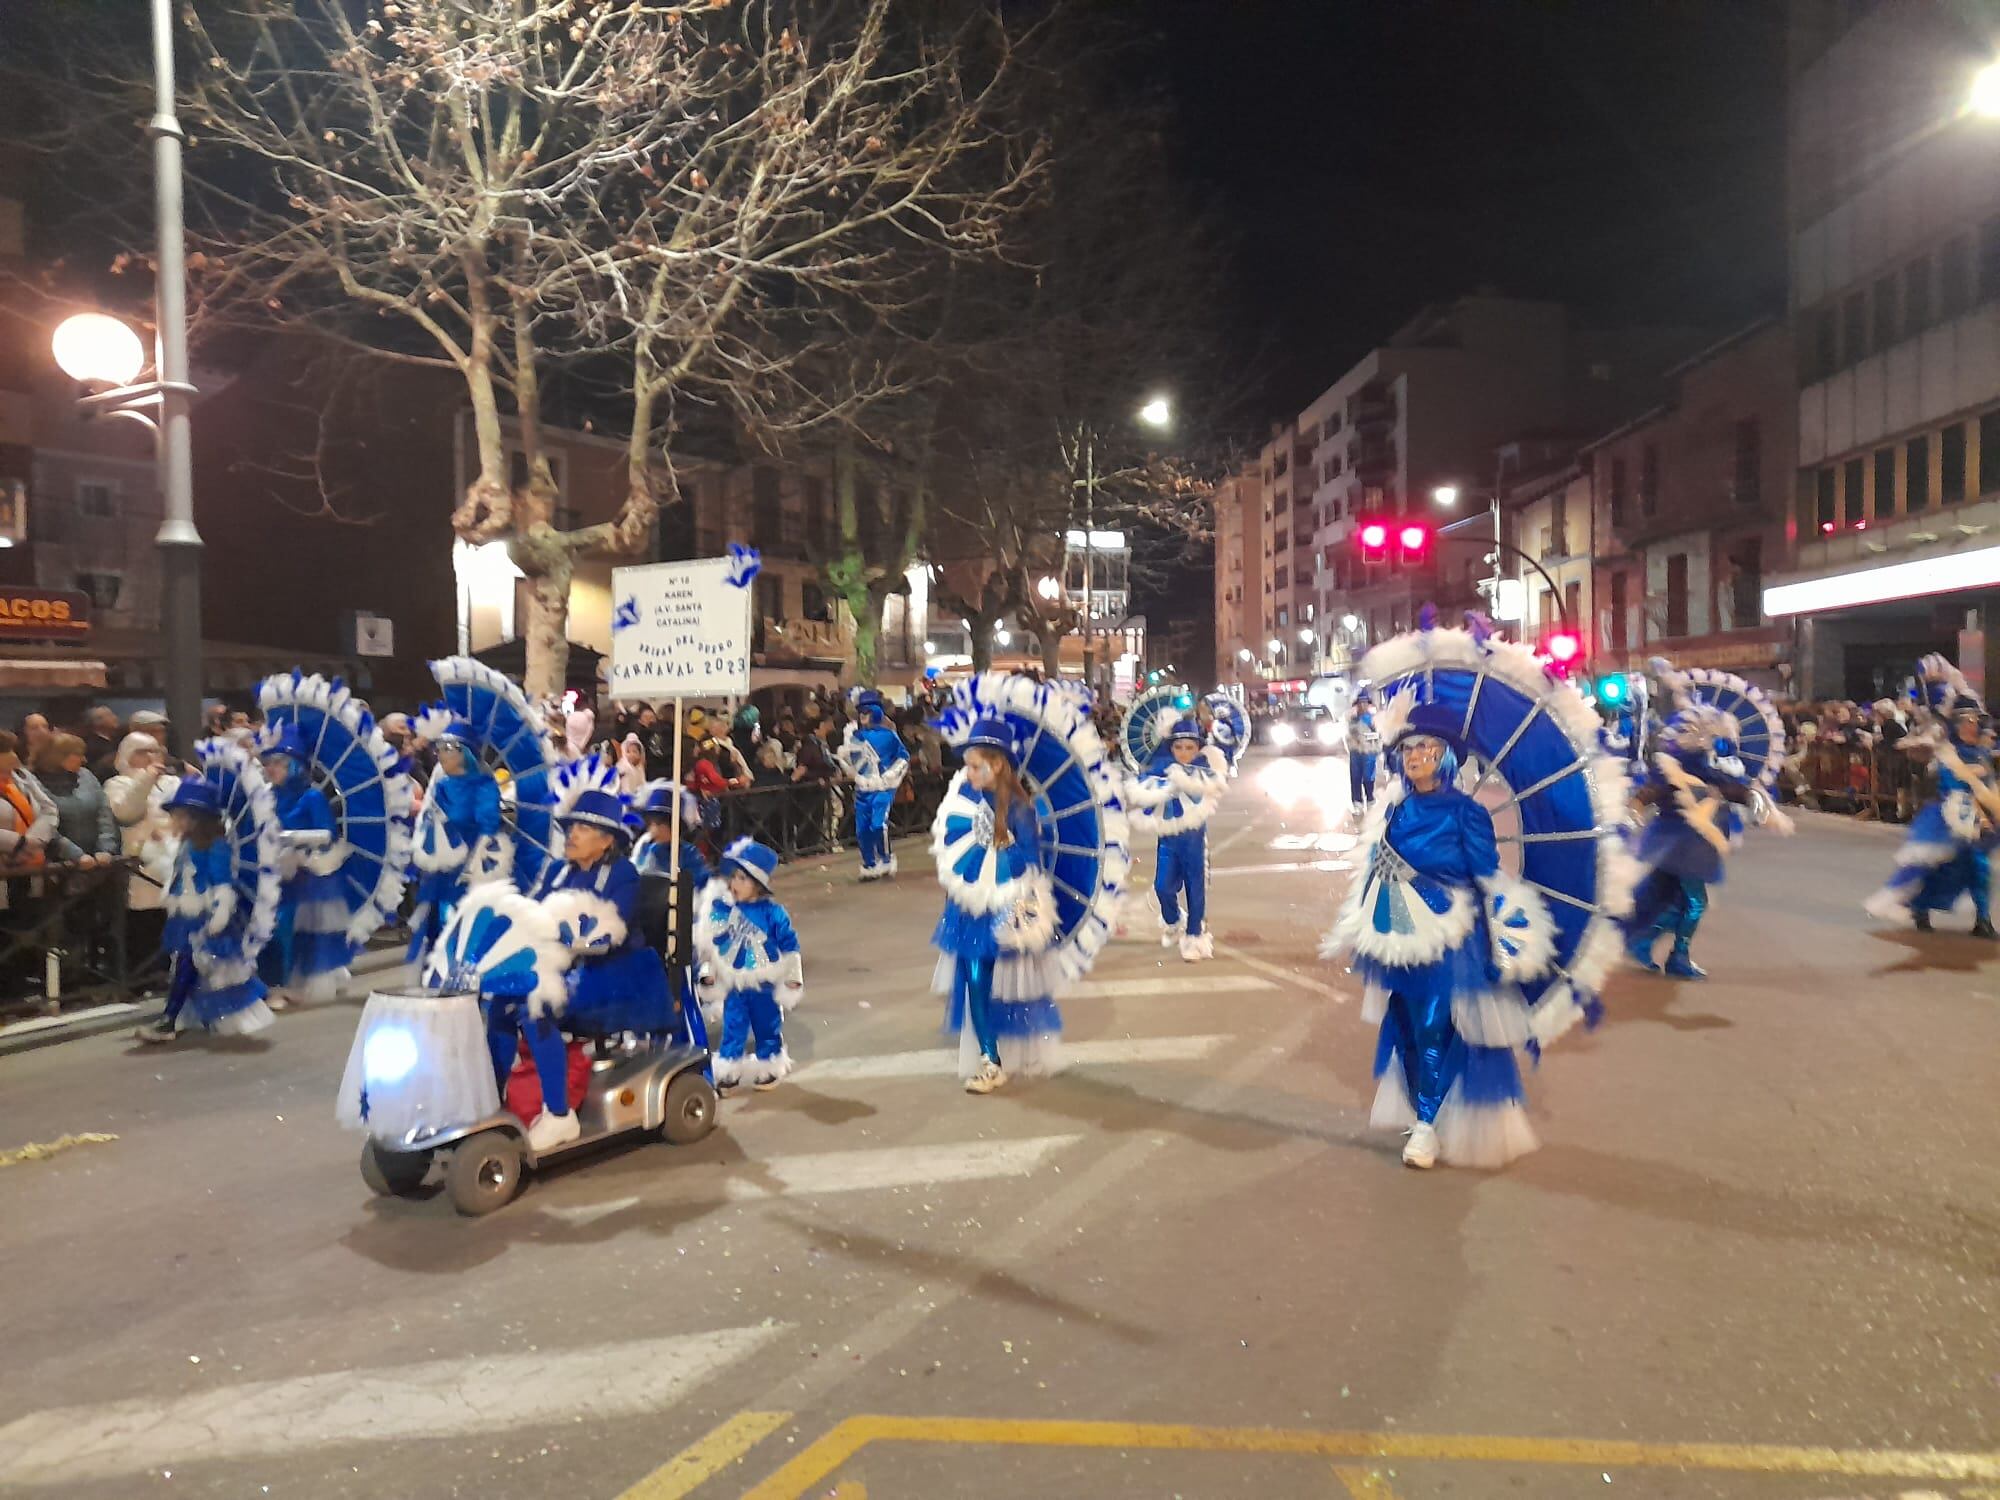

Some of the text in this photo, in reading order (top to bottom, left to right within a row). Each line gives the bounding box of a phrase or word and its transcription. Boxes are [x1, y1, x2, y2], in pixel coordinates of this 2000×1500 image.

[664, 590, 693, 599] KAREN
[675, 602, 703, 612] SANTA
[675, 633, 695, 647] DEL
[613, 657, 745, 679] CARNAVAL 2023
